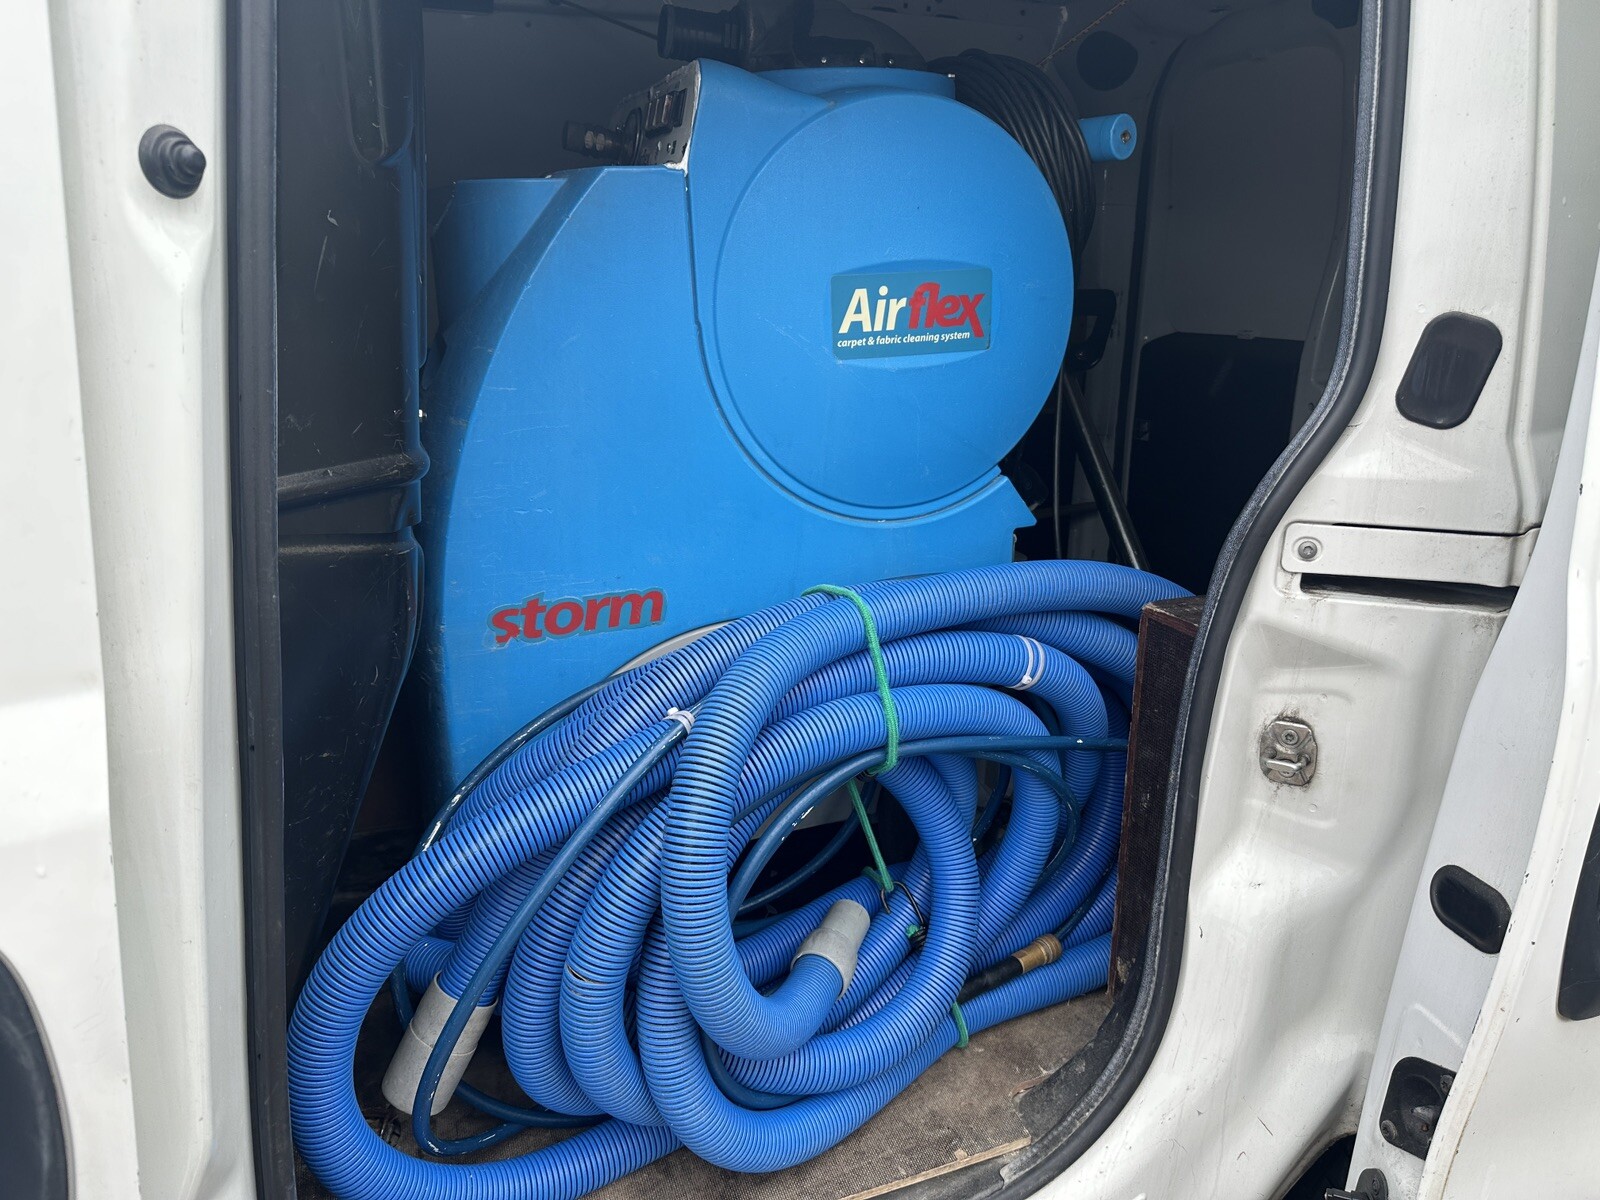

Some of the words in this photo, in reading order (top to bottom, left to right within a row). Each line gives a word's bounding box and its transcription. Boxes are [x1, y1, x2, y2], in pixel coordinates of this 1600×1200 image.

[838, 282, 985, 338] Airflex
[837, 336, 866, 349] carpet
[867, 336, 875, 346] &
[876, 334, 901, 346] fabric
[902, 332, 940, 344] cleaning
[941, 331, 970, 342] system
[492, 590, 664, 644] storm
